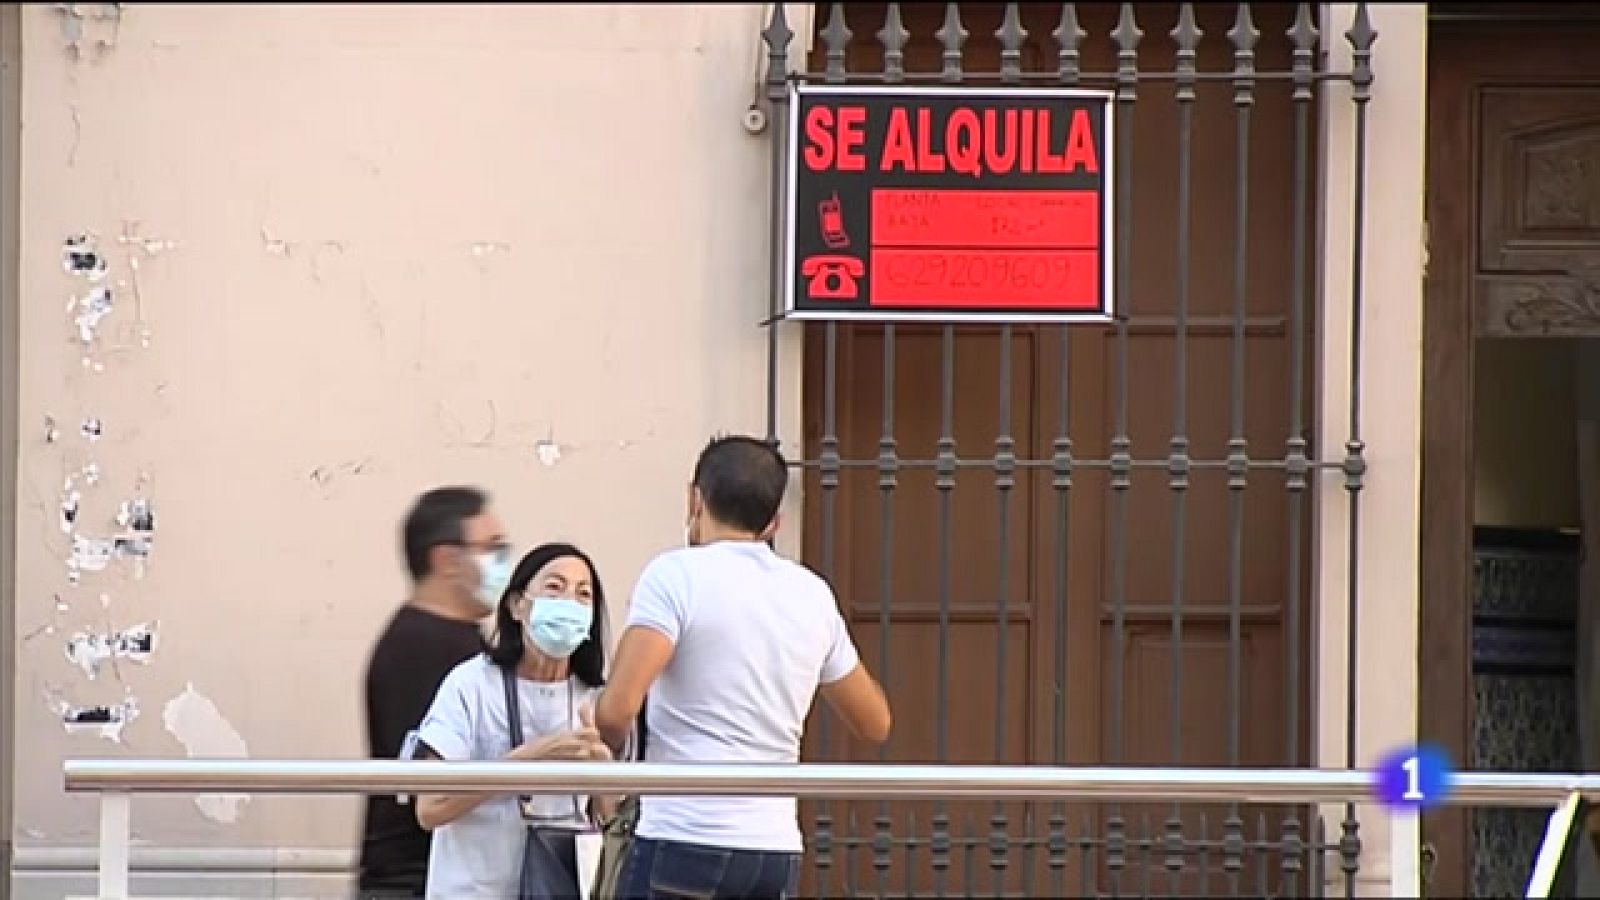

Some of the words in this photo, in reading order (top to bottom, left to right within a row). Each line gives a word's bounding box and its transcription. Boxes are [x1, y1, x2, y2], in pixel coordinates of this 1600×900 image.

[803, 106, 866, 172] SE
[880, 106, 1098, 178] ALQUILA
[885, 254, 1071, 288] 629209609
